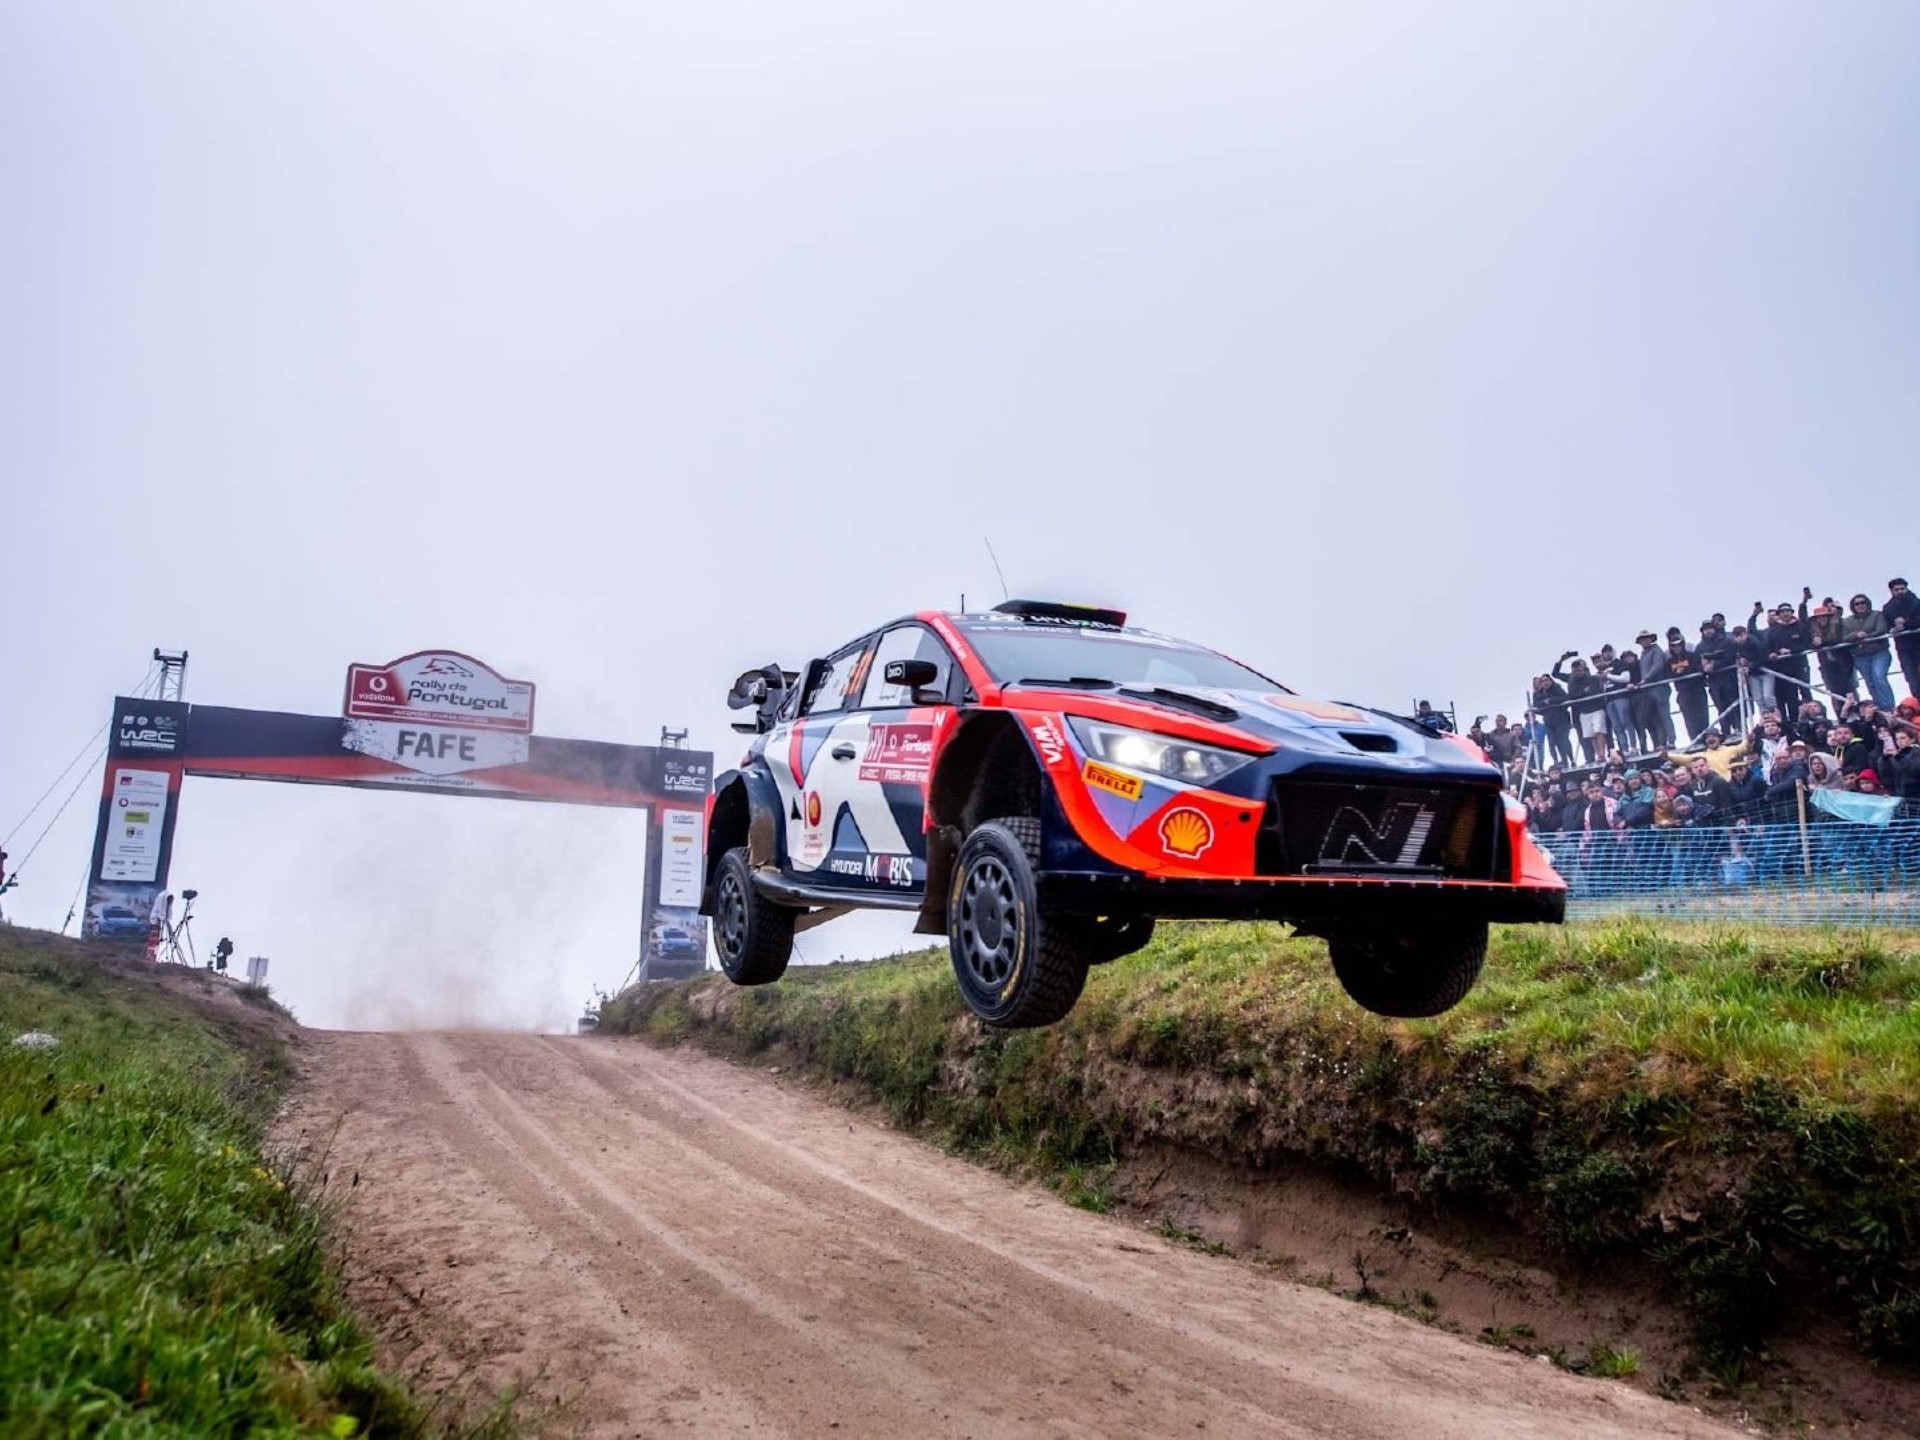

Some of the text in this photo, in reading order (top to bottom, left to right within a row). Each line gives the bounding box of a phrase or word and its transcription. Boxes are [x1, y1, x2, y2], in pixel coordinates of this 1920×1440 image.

[410, 680, 468, 692] rally de
[358, 692, 395, 703] vodafone
[407, 688, 509, 711] Portugal
[120, 728, 177, 743] WRC
[397, 730, 477, 762] FAFE
[664, 774, 706, 787] WRC
[1086, 765, 1138, 796] PIRELLI
